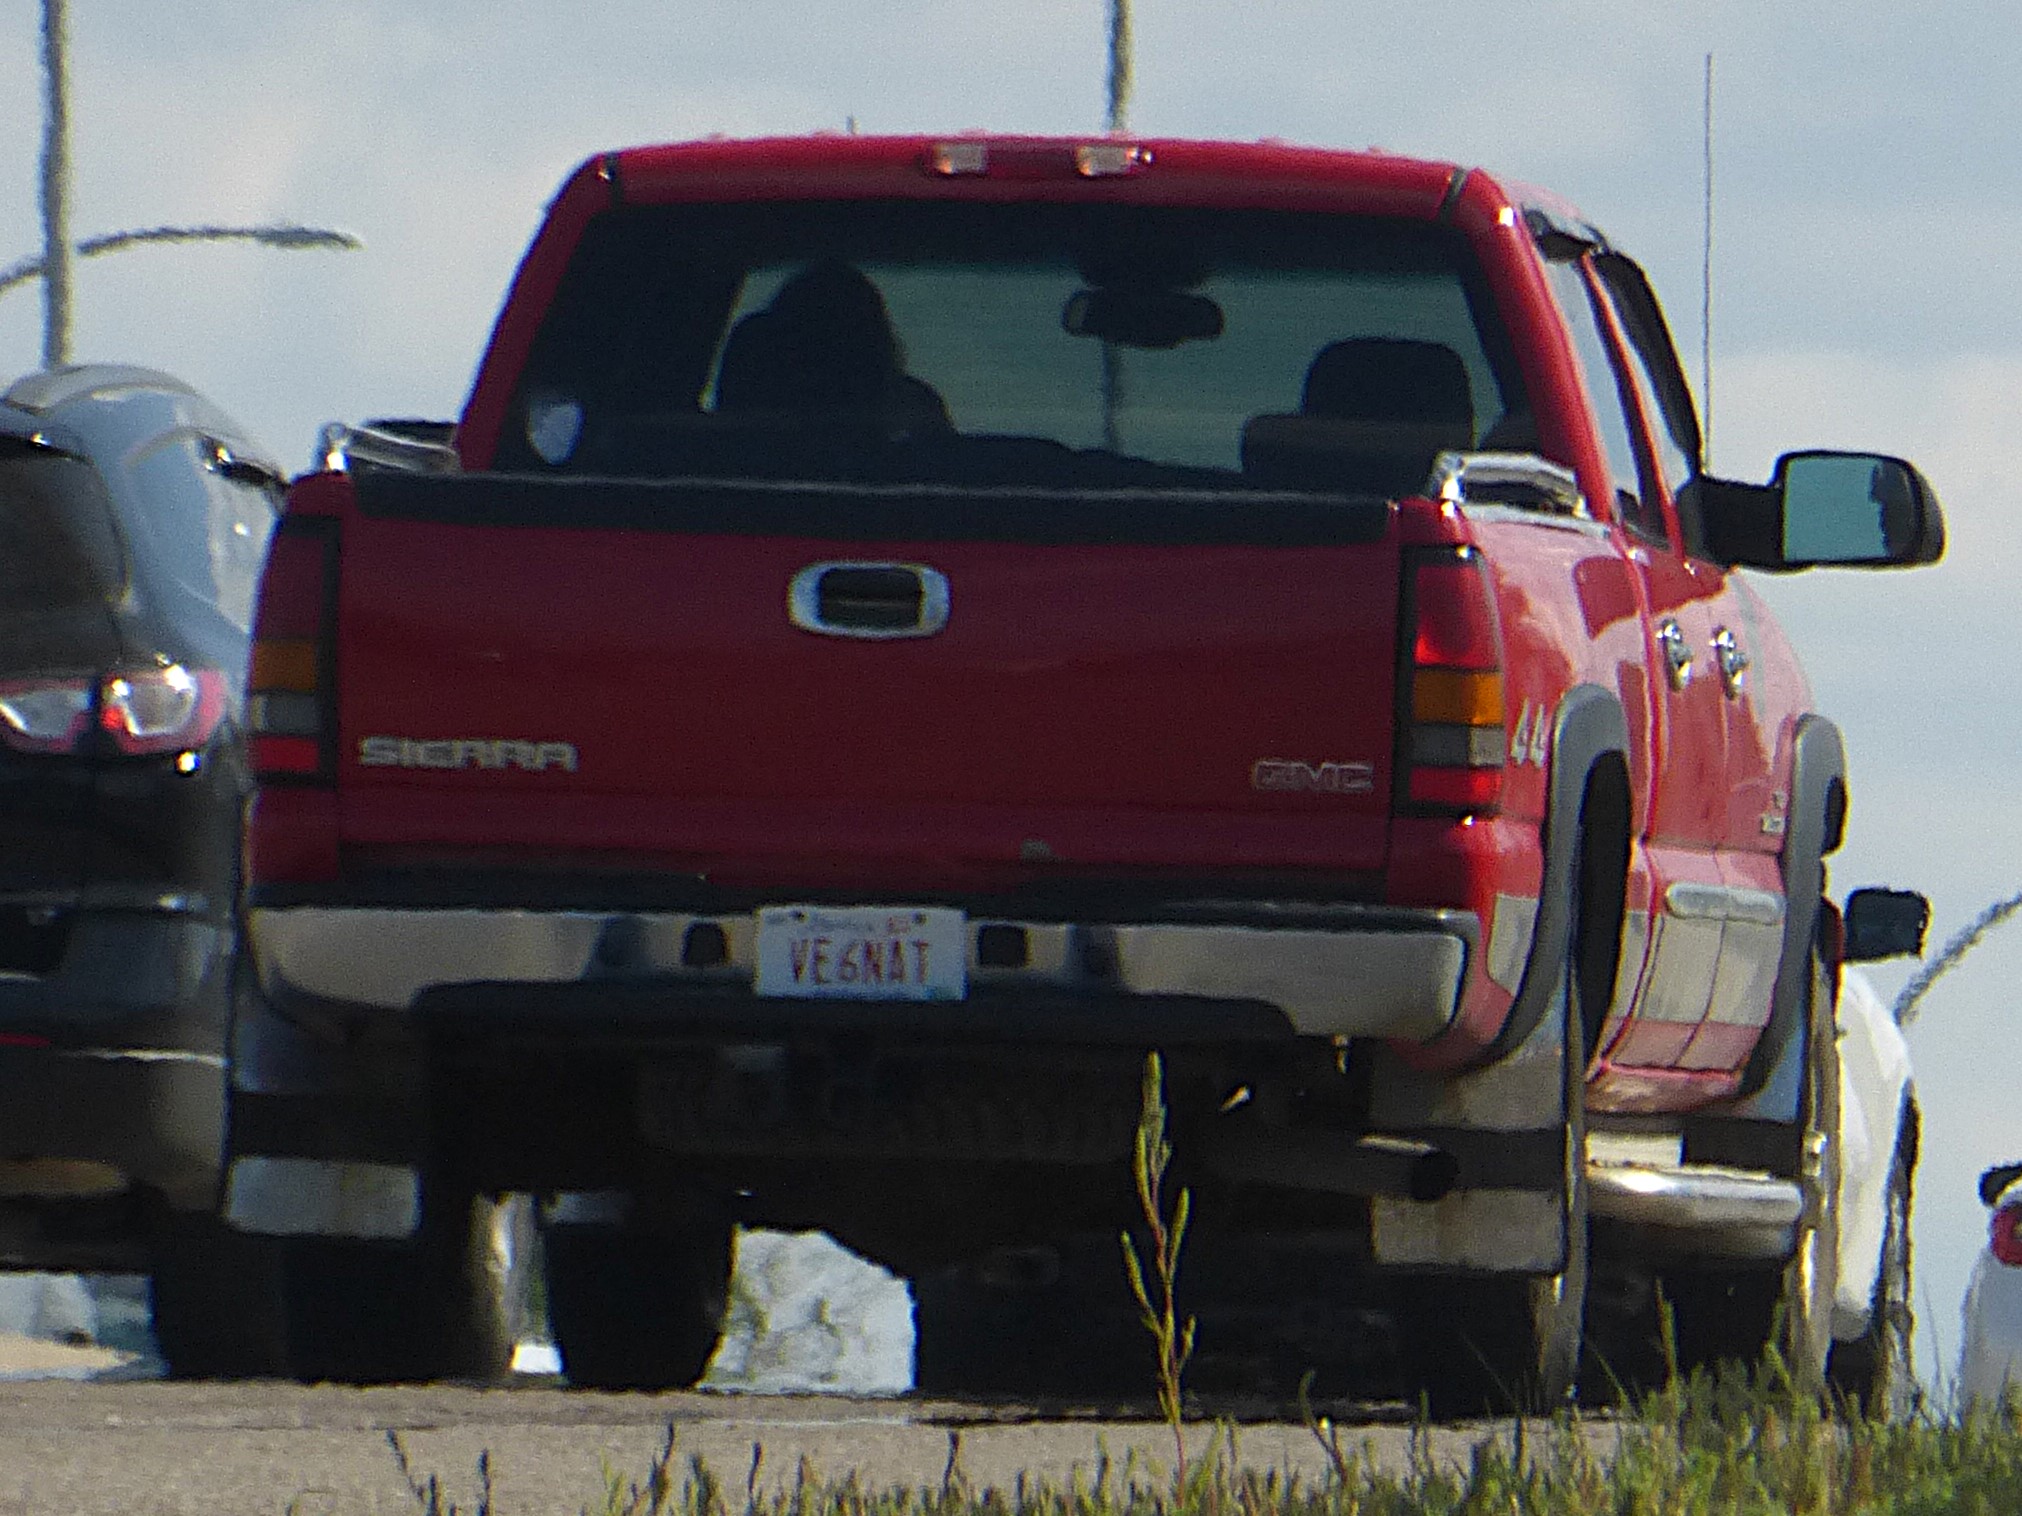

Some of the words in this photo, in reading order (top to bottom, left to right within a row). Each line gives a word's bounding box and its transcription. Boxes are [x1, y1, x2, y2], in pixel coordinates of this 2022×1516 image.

[360, 736, 578, 772] SIERRA
[1255, 760, 1374, 792] GMC
[790, 937, 930, 985] VE6NAT
